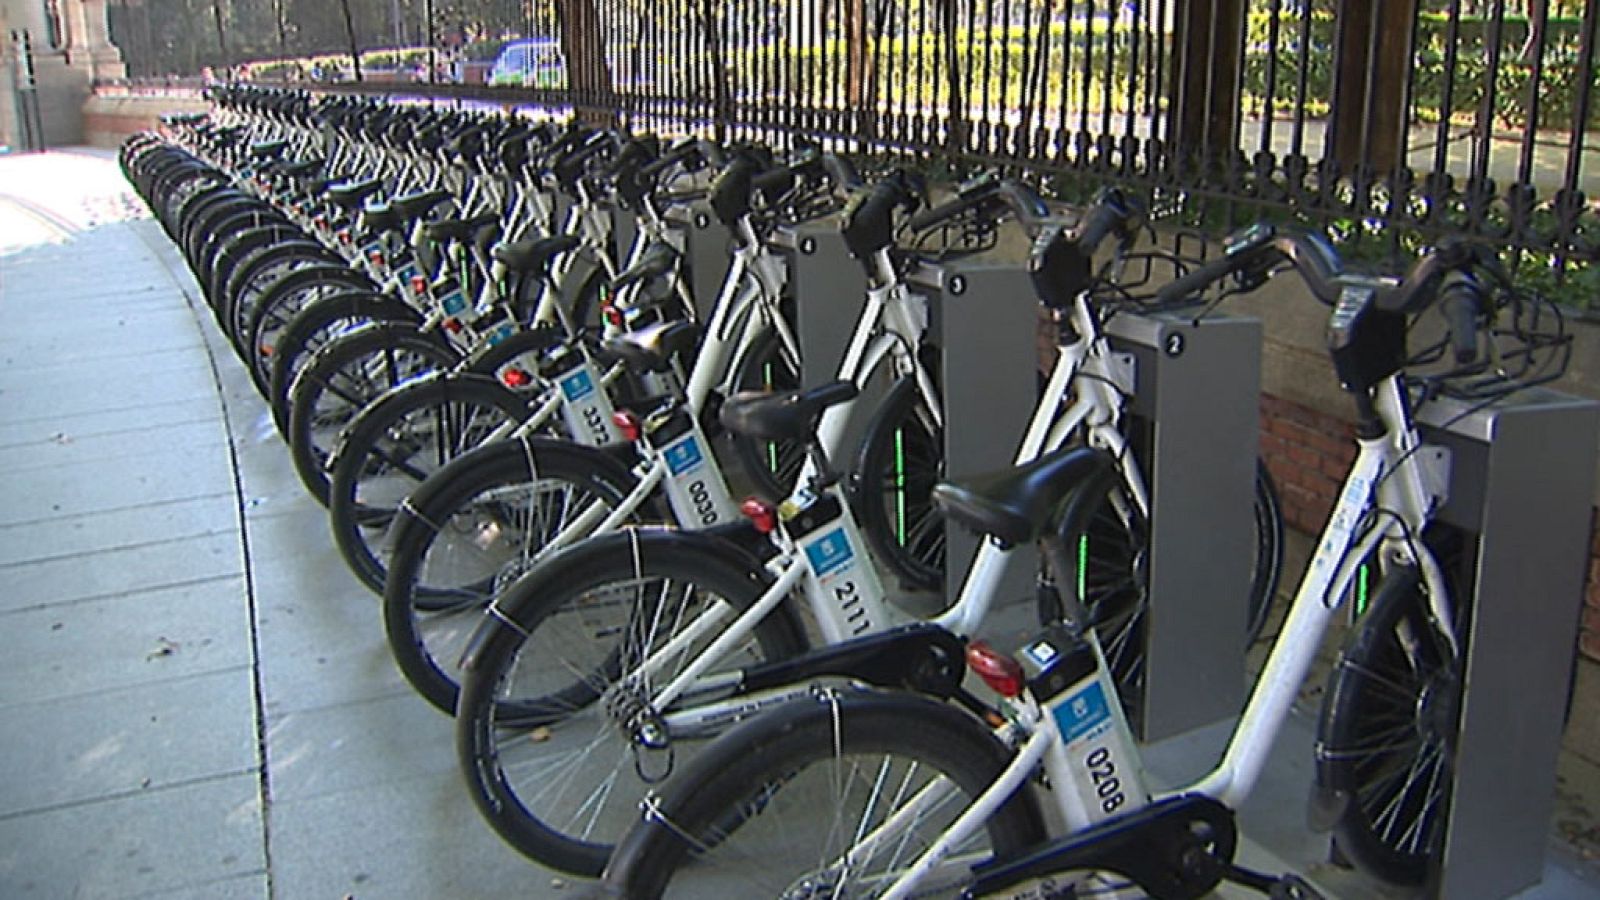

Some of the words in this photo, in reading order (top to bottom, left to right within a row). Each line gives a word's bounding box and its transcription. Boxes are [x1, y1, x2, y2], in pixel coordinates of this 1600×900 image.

[1169, 336, 1179, 353] 2
[582, 406, 609, 446] 3372
[688, 480, 718, 525] 0030
[835, 581, 869, 635] 2111
[1086, 747, 1125, 813] 0208
